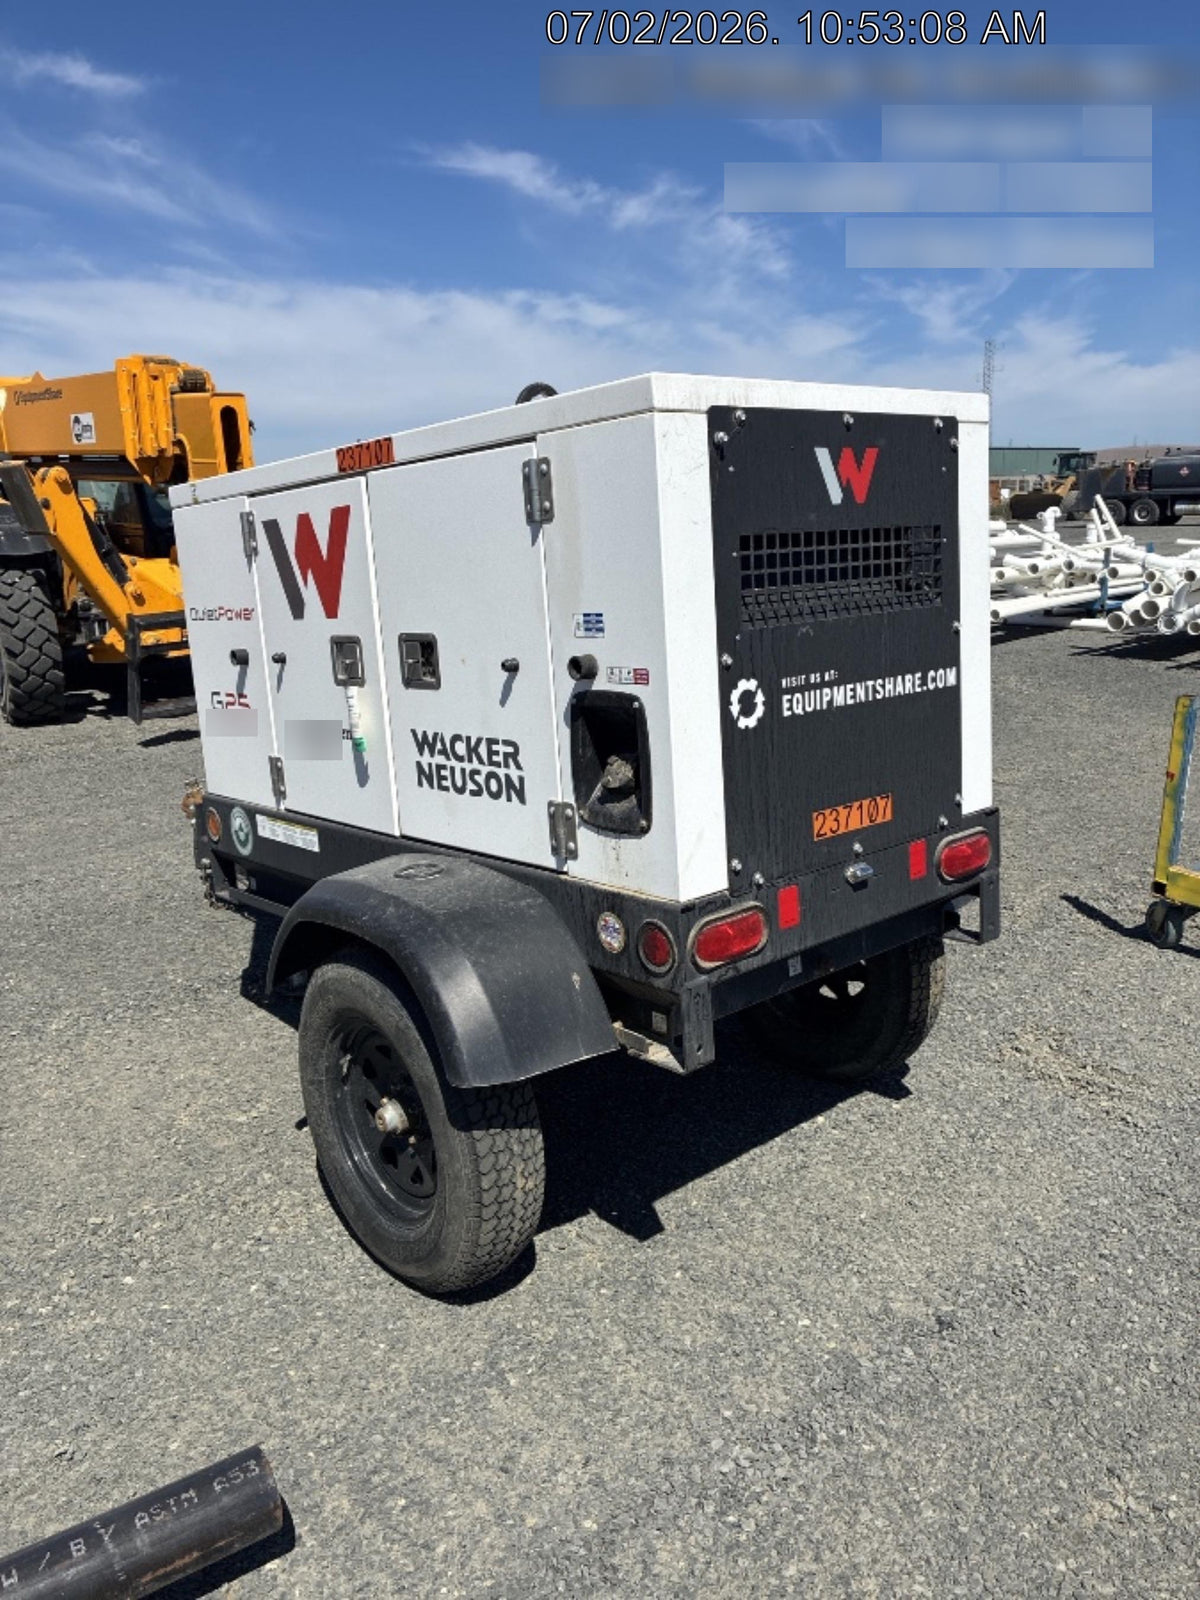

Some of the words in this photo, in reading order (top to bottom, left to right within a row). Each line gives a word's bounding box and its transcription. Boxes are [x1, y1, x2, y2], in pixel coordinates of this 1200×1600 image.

[336, 436, 395, 473] 237107
[781, 674, 806, 689] VISIT
[809, 671, 821, 684] US
[781, 666, 958, 717] EQUIPMENTSHARE.COM
[410, 728, 524, 772] WACKER
[415, 760, 527, 806] NEUSON
[814, 794, 892, 839] 237107
